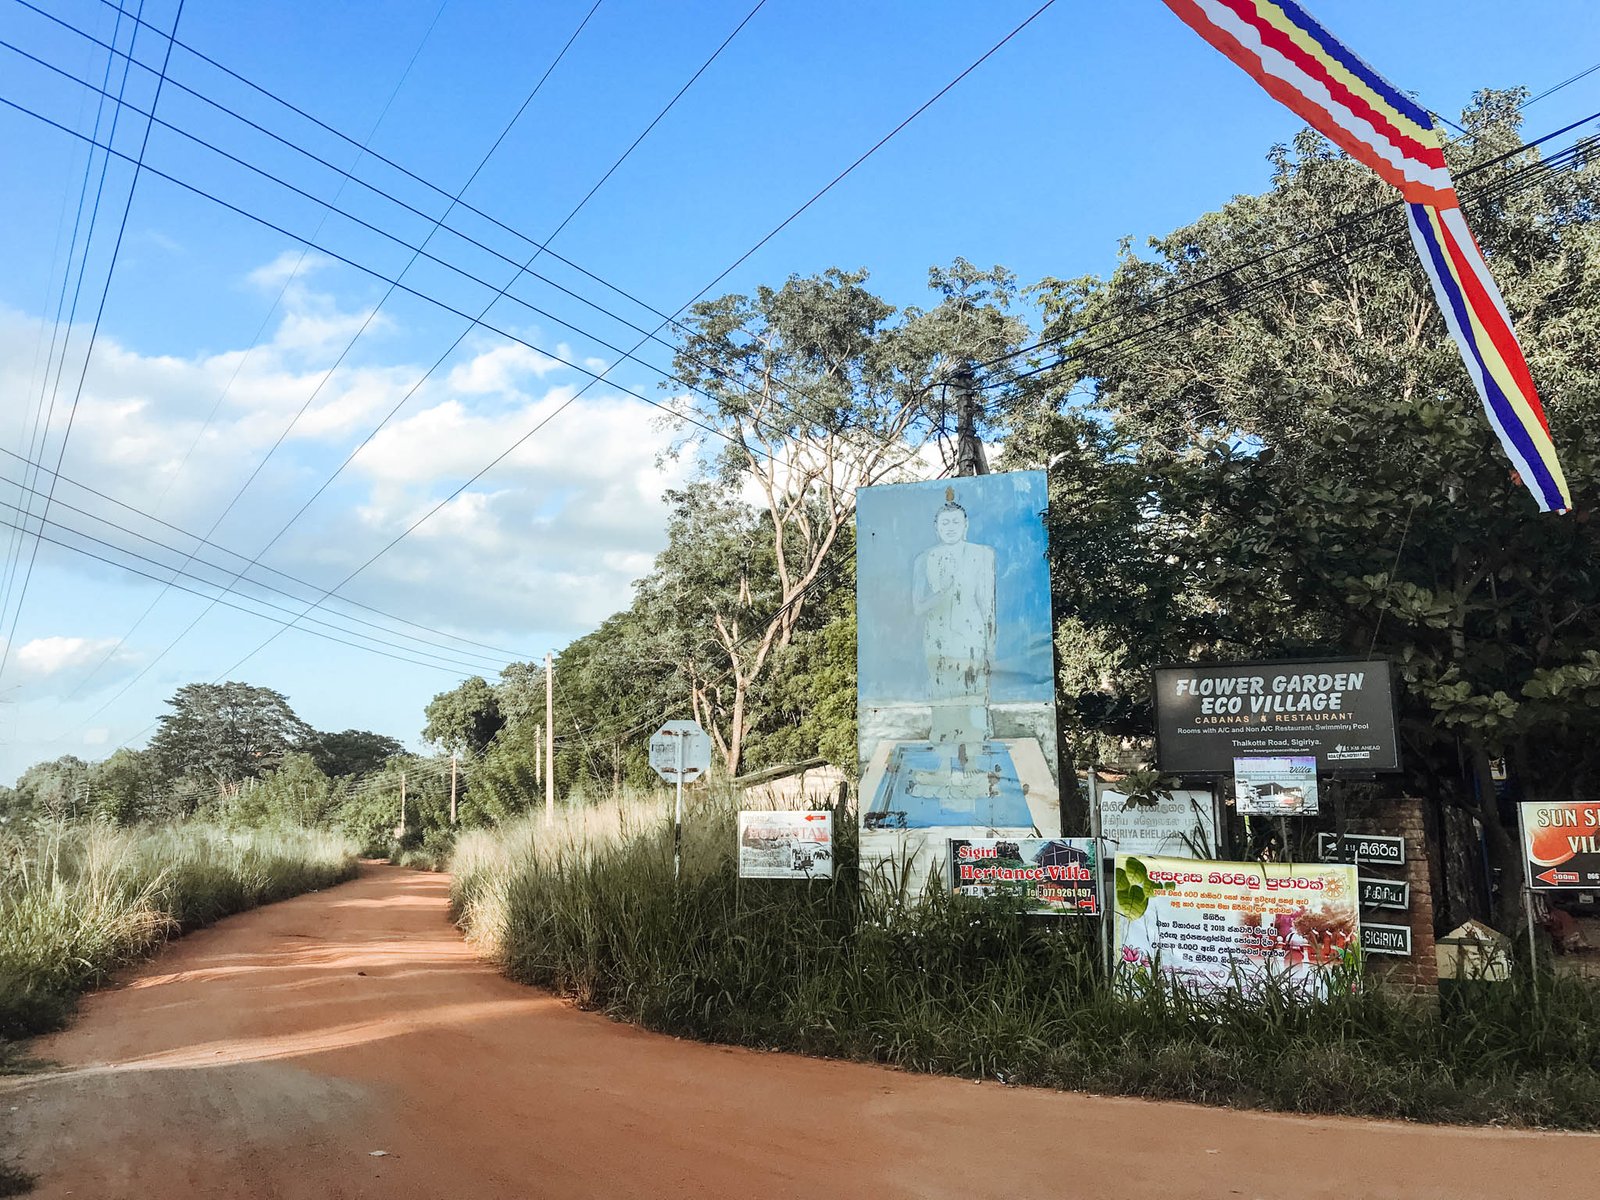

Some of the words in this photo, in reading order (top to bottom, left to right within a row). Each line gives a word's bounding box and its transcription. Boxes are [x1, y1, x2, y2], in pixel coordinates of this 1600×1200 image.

[1176, 676, 1265, 696] FLOWER
[1272, 672, 1364, 694] GARDEN
[1201, 696, 1242, 714] ECO
[1250, 692, 1342, 714] VILLAGE
[1194, 716, 1250, 724] CABANAS
[1260, 715, 1267, 723] &
[1276, 712, 1354, 722] RESTAURANT
[1218, 726, 1230, 734] A/C
[1274, 724, 1314, 732] Restaurant,
[1352, 722, 1369, 730] Pool
[1290, 738, 1322, 747] Sigiriya.
[1537, 808, 1578, 828] SUN
[1104, 828, 1138, 839] SIGIRIYA
[959, 846, 997, 860] Sigiri
[960, 865, 1043, 880] Heritance
[1046, 865, 1090, 880] Villa
[1149, 870, 1203, 884] අසදෘස
[1043, 888, 1056, 897] 077
[1057, 888, 1076, 898] 9261
[1076, 888, 1091, 898] 497
[1210, 924, 1225, 932] 2018
[1364, 930, 1404, 948] SIGIRIYA
